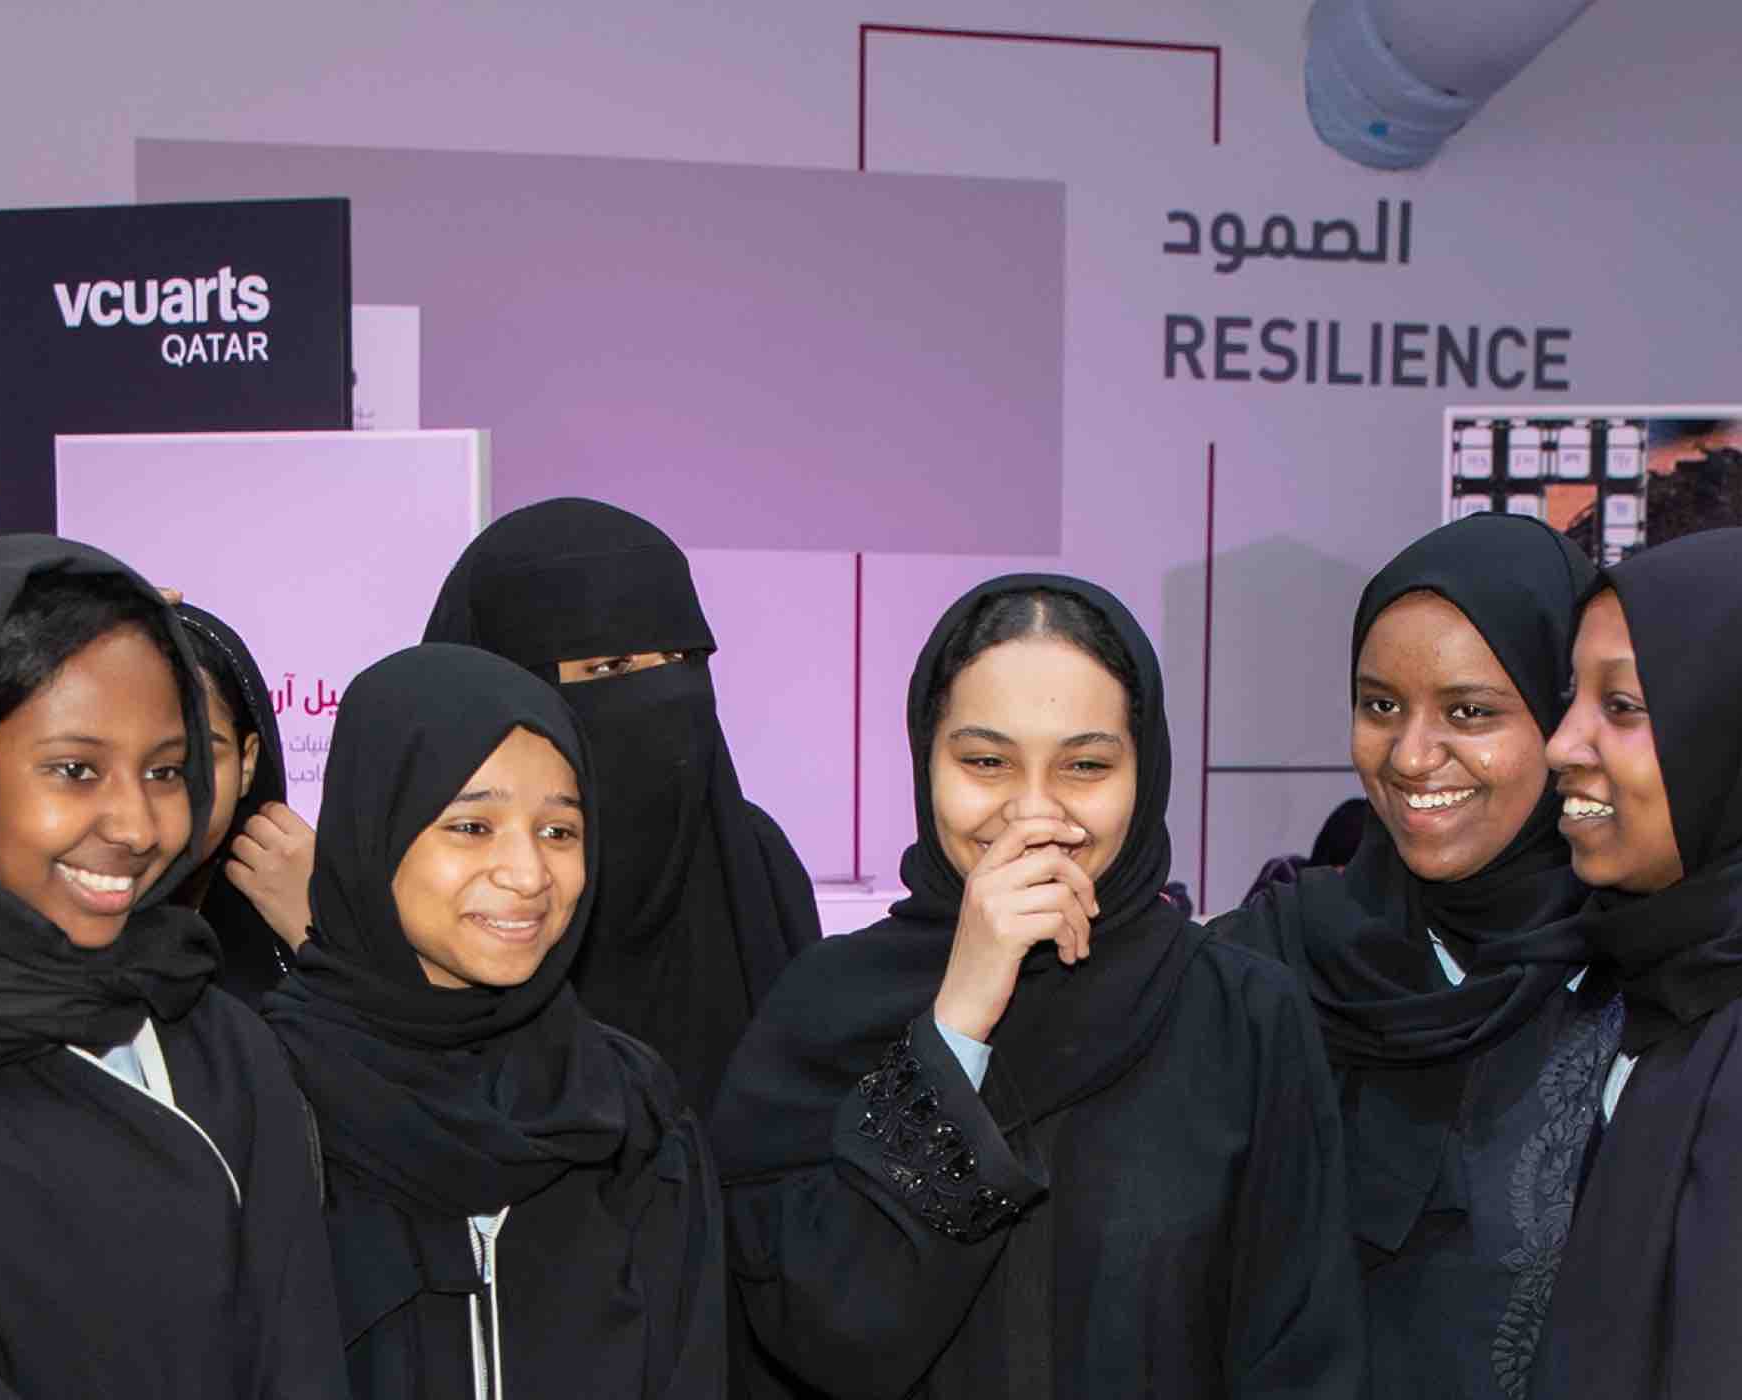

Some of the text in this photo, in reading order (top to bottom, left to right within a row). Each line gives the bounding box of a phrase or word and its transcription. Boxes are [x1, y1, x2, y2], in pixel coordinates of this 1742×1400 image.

[1163, 199, 1411, 274] الصمود
[53, 266, 271, 328] vcuarts
[161, 331, 270, 367] QATAR
[1163, 313, 1572, 391] RESILIENCE
[268, 673, 339, 717] يل آر
